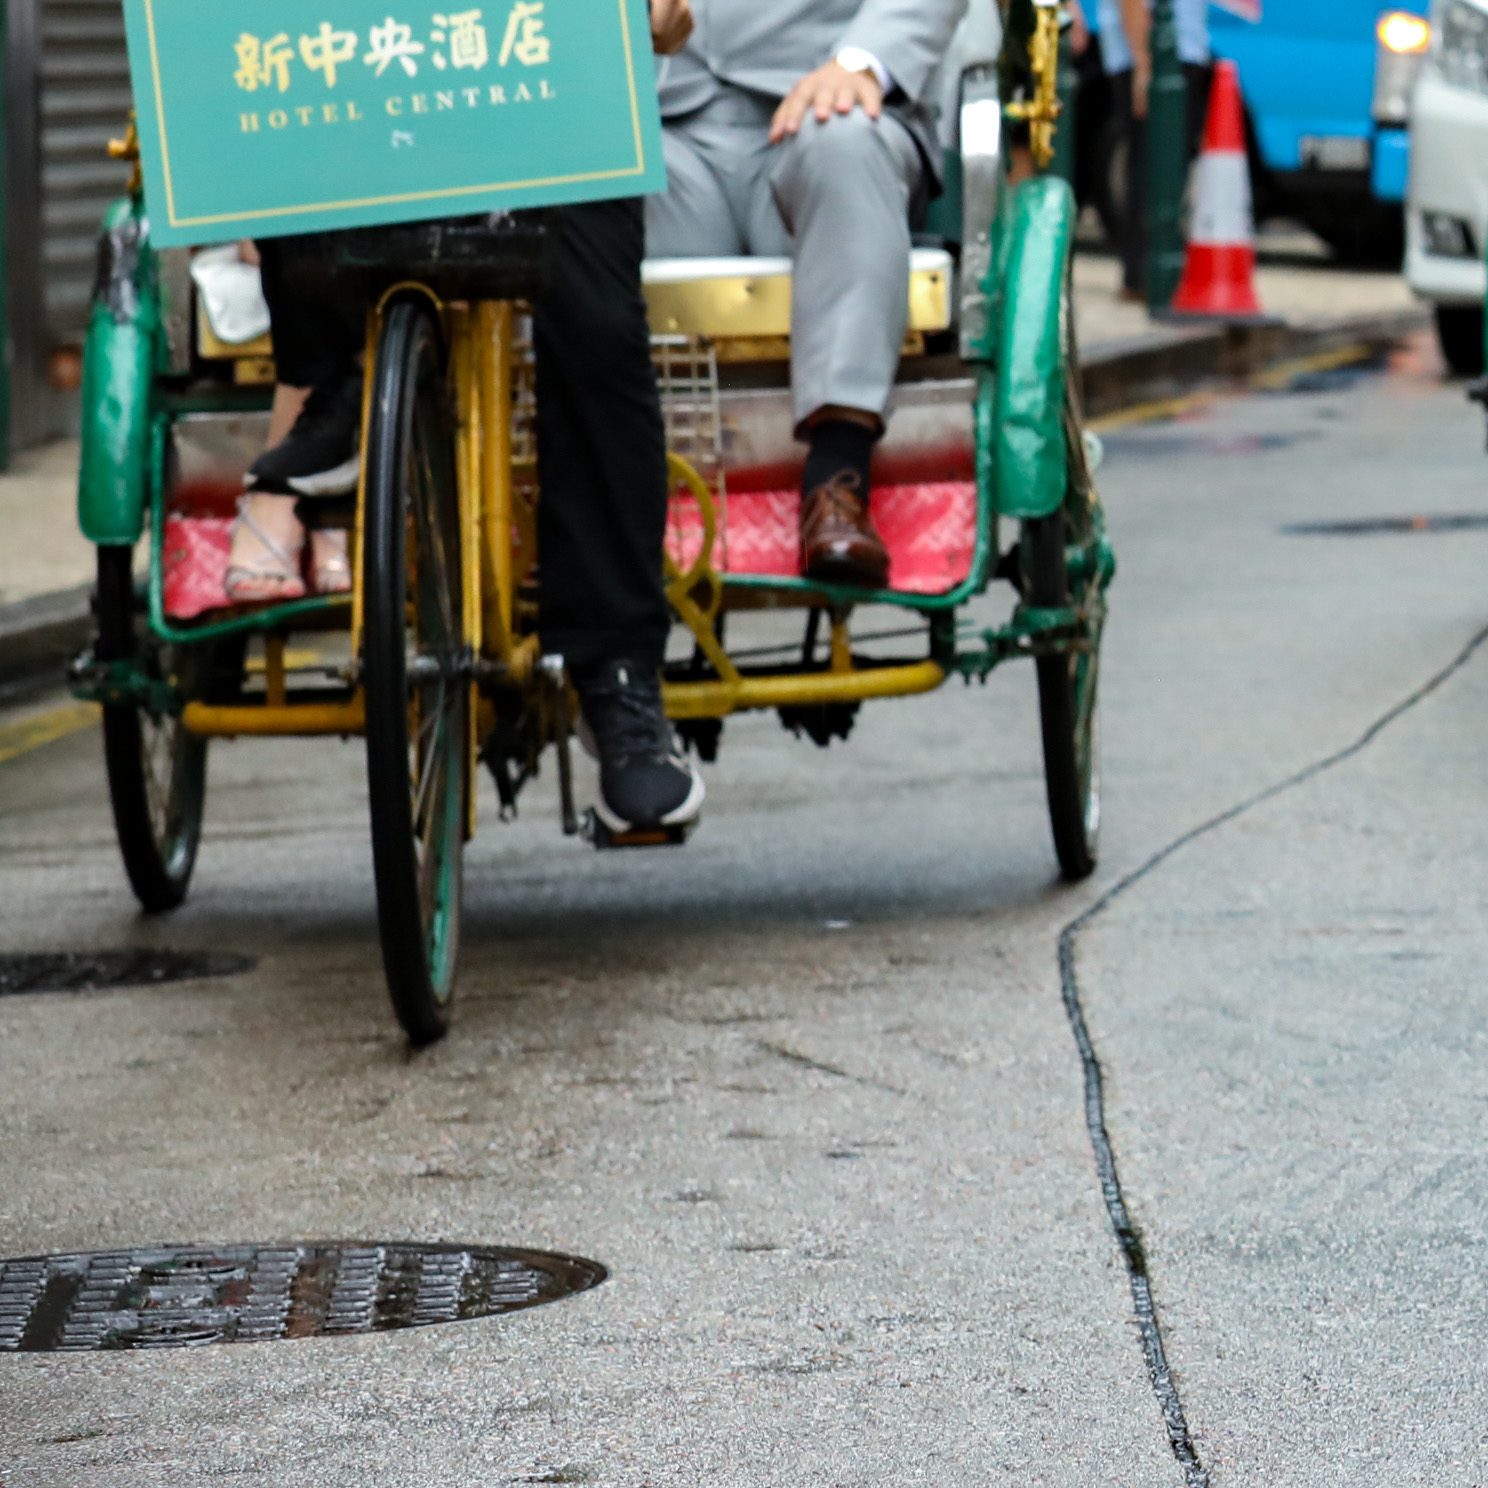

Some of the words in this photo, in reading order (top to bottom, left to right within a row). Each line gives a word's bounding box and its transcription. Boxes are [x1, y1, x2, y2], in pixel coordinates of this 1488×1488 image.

[233, 0, 551, 94] 新中央酒店
[240, 100, 363, 133] HOTEL
[385, 79, 556, 117] CENTRAL
